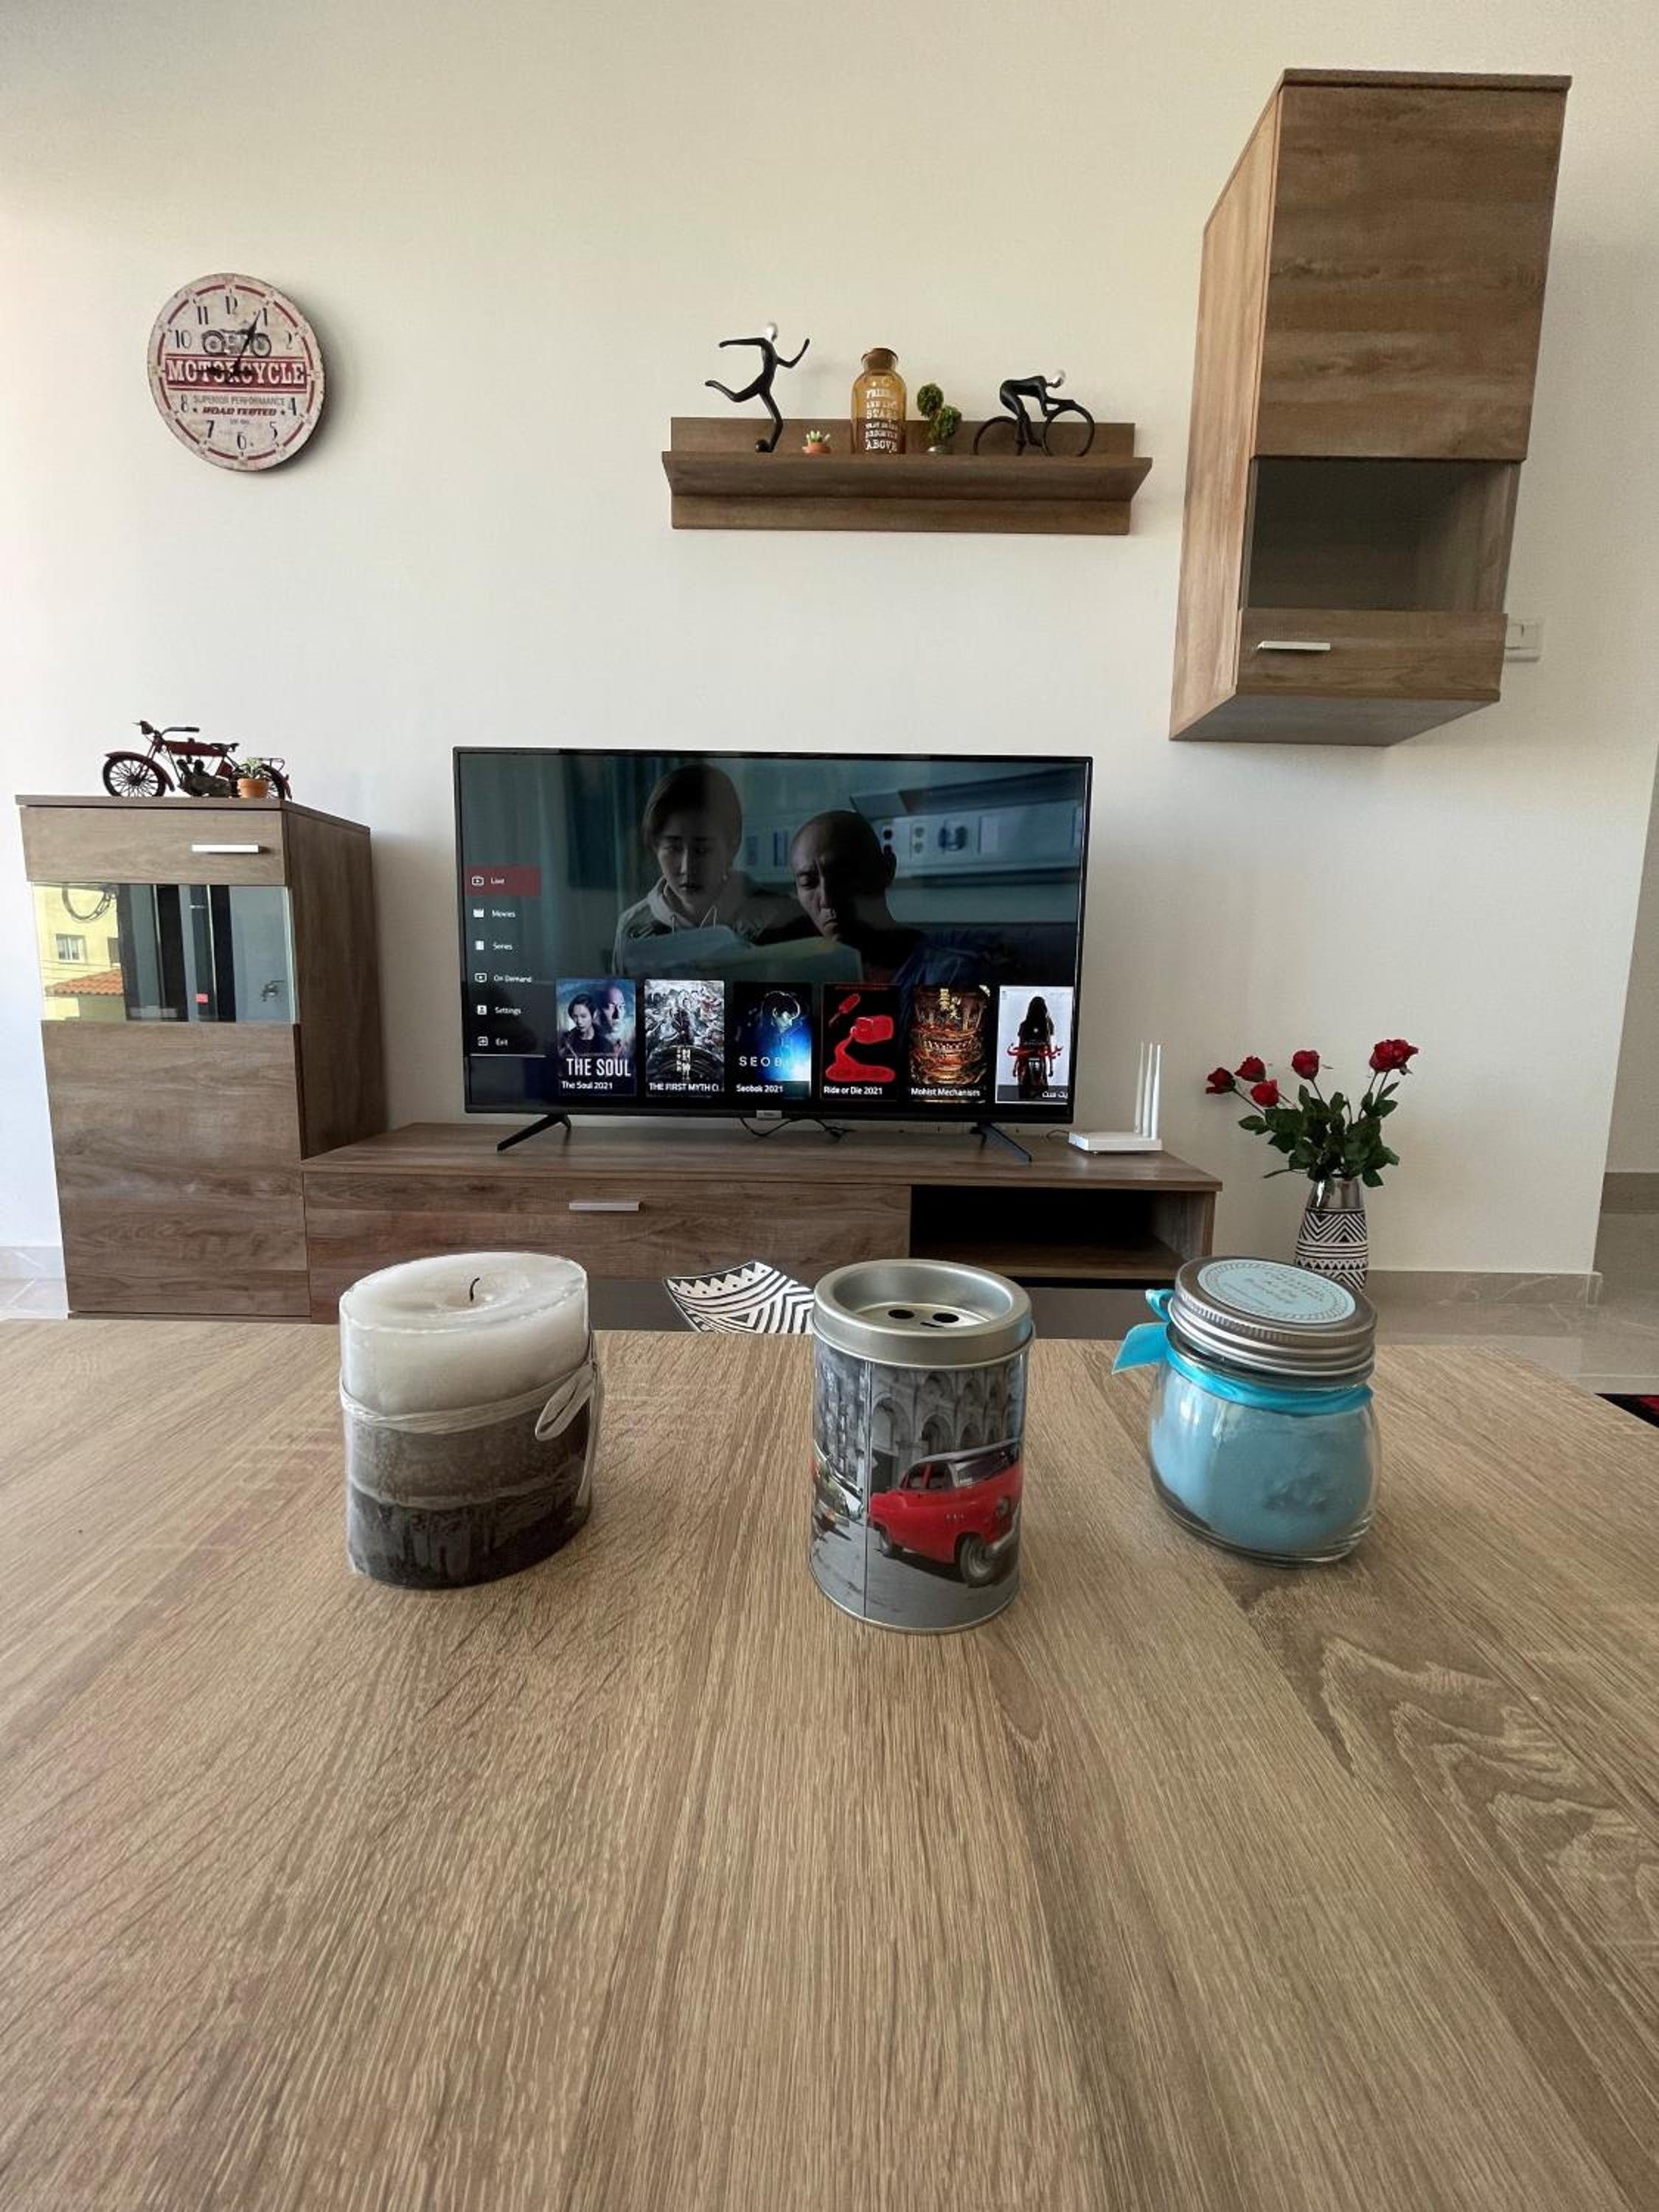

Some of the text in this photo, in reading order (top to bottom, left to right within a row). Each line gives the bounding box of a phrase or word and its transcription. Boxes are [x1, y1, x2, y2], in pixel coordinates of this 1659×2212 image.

[226, 296, 238, 316] 12
[197, 306, 209, 325] 11
[175, 330, 192, 349] 10
[285, 330, 293, 350] 2
[166, 359, 305, 384] MOTORCYCLE
[206, 420, 215, 439] 7
[269, 421, 278, 441] 5
[237, 431, 247, 451] 6
[492, 909, 516, 918] Movies
[493, 942, 514, 950] Series
[495, 1006, 521, 1016] Settings
[495, 1037, 508, 1046] Exit
[566, 1058, 632, 1077] THE SOUL
[561, 1080, 613, 1091] The Soul 2021
[649, 1082, 664, 1091] THE
[665, 1083, 687, 1091] FIRST
[688, 1083, 711, 1092] MYTH
[736, 1084, 784, 1093] Seobok 2021
[824, 1085, 840, 1094] Ride
[850, 1086, 863, 1095] Die
[863, 1087, 883, 1096] 2021
[911, 1088, 981, 1097] Mohist Mechanism
